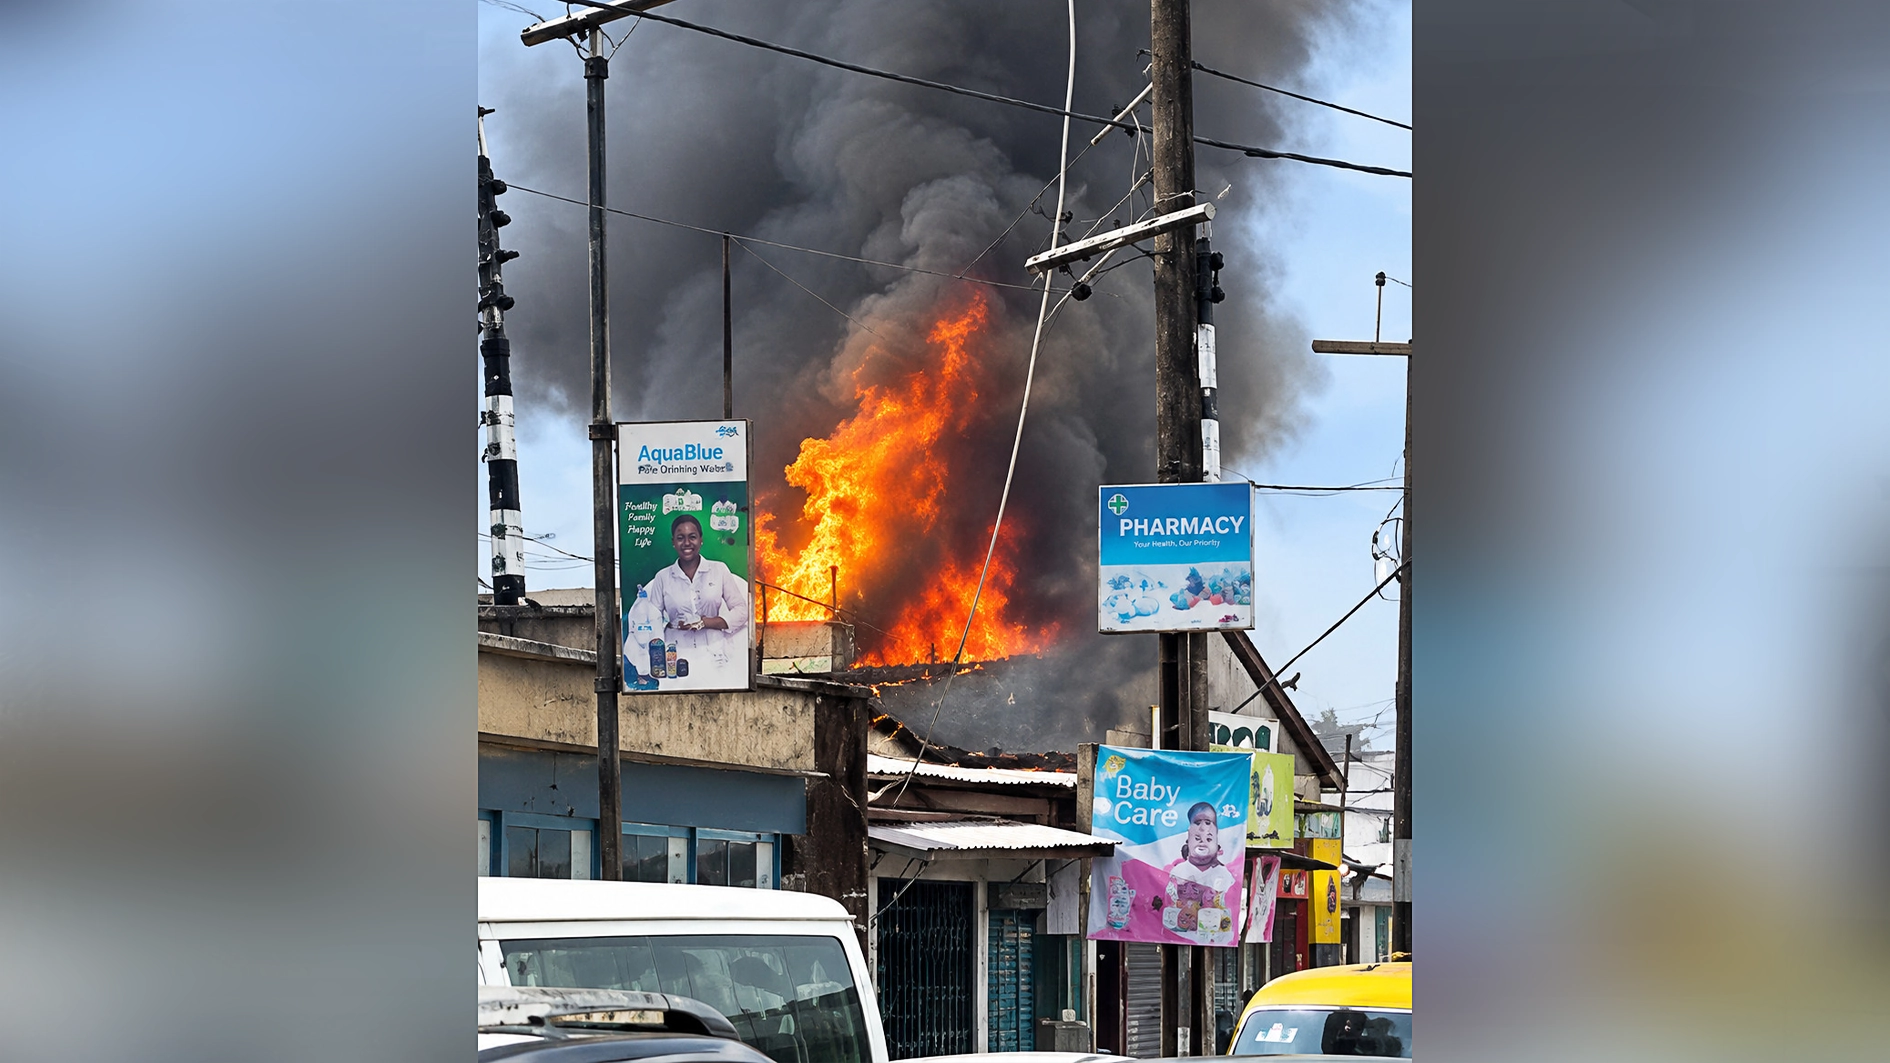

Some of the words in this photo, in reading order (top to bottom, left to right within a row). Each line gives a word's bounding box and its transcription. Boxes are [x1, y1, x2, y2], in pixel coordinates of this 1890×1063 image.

[638, 443, 723, 465] AquaBlue
[1120, 516, 1244, 536] PHARMACY
[1133, 541, 1150, 549] Your
[1179, 539, 1192, 547] Our
[1194, 539, 1221, 548] Priority
[1116, 774, 1180, 807] Baby
[1114, 801, 1179, 827] Care
